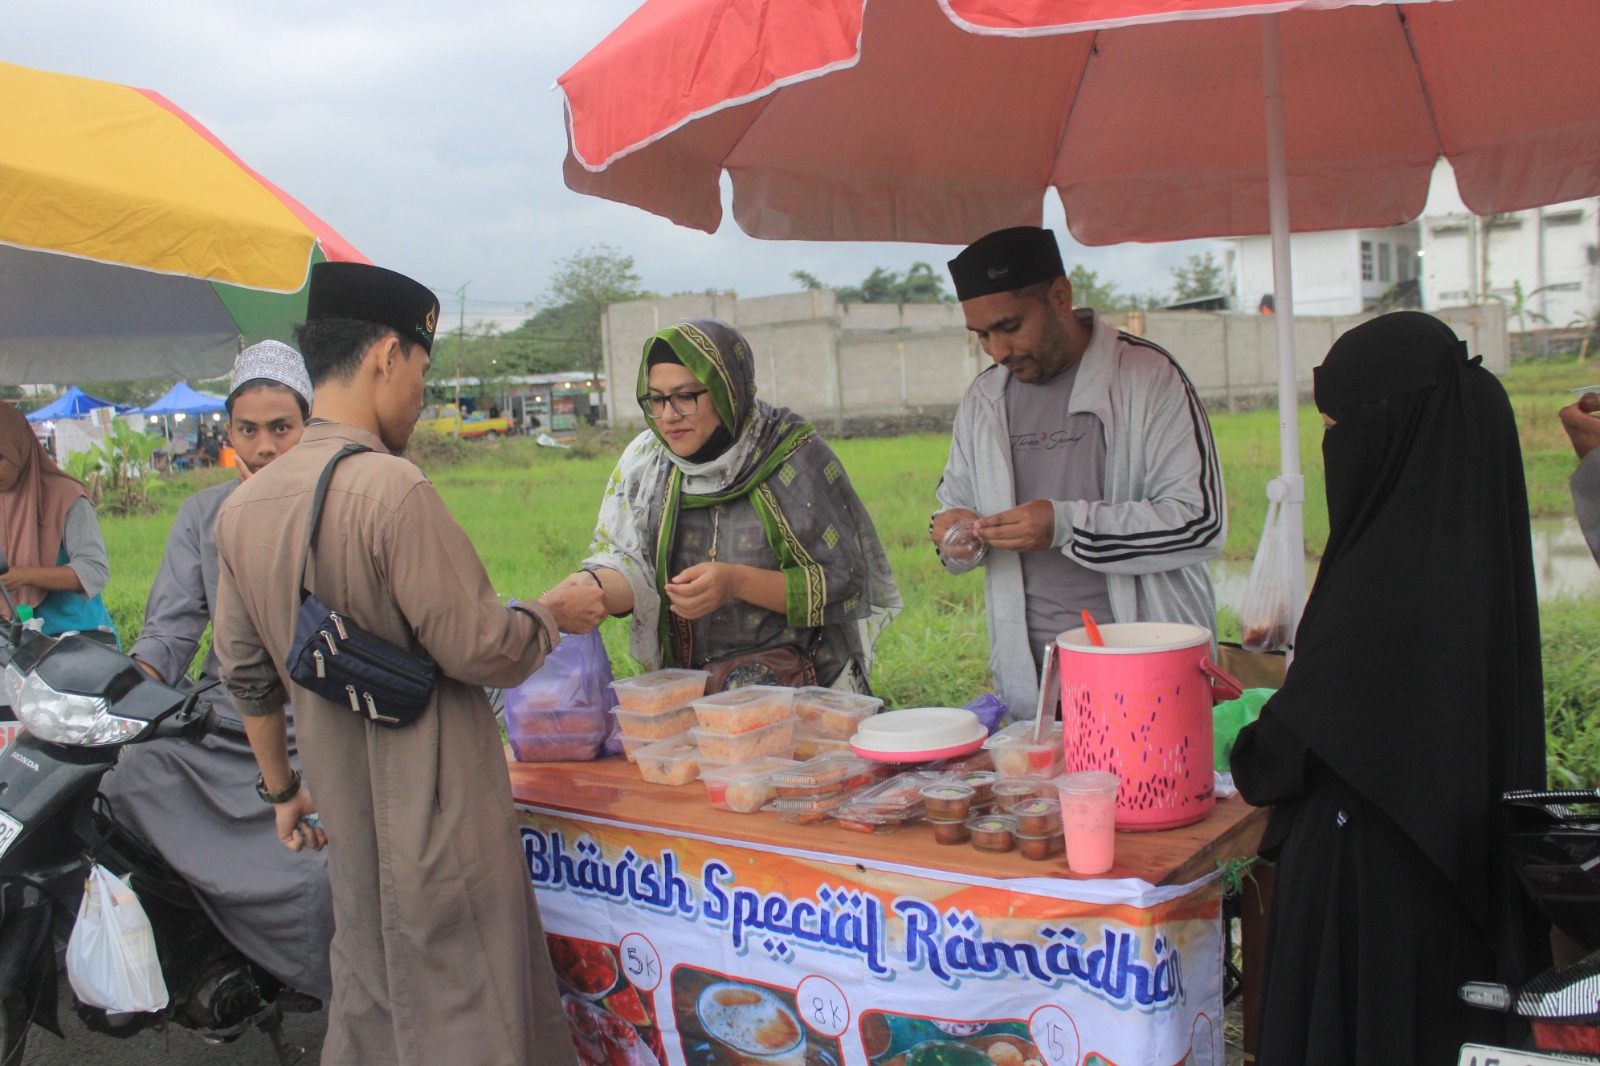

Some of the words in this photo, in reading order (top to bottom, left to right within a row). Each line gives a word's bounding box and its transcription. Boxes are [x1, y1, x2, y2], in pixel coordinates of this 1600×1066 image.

[1010, 434, 1041, 450] Three
[11, 751, 40, 772] HONDA
[703, 862, 888, 974] Special
[894, 899, 1184, 1005] Ramadhan
[627, 947, 657, 977] 5K
[812, 996, 842, 1029] 8K
[1046, 1022, 1065, 1062] 15
